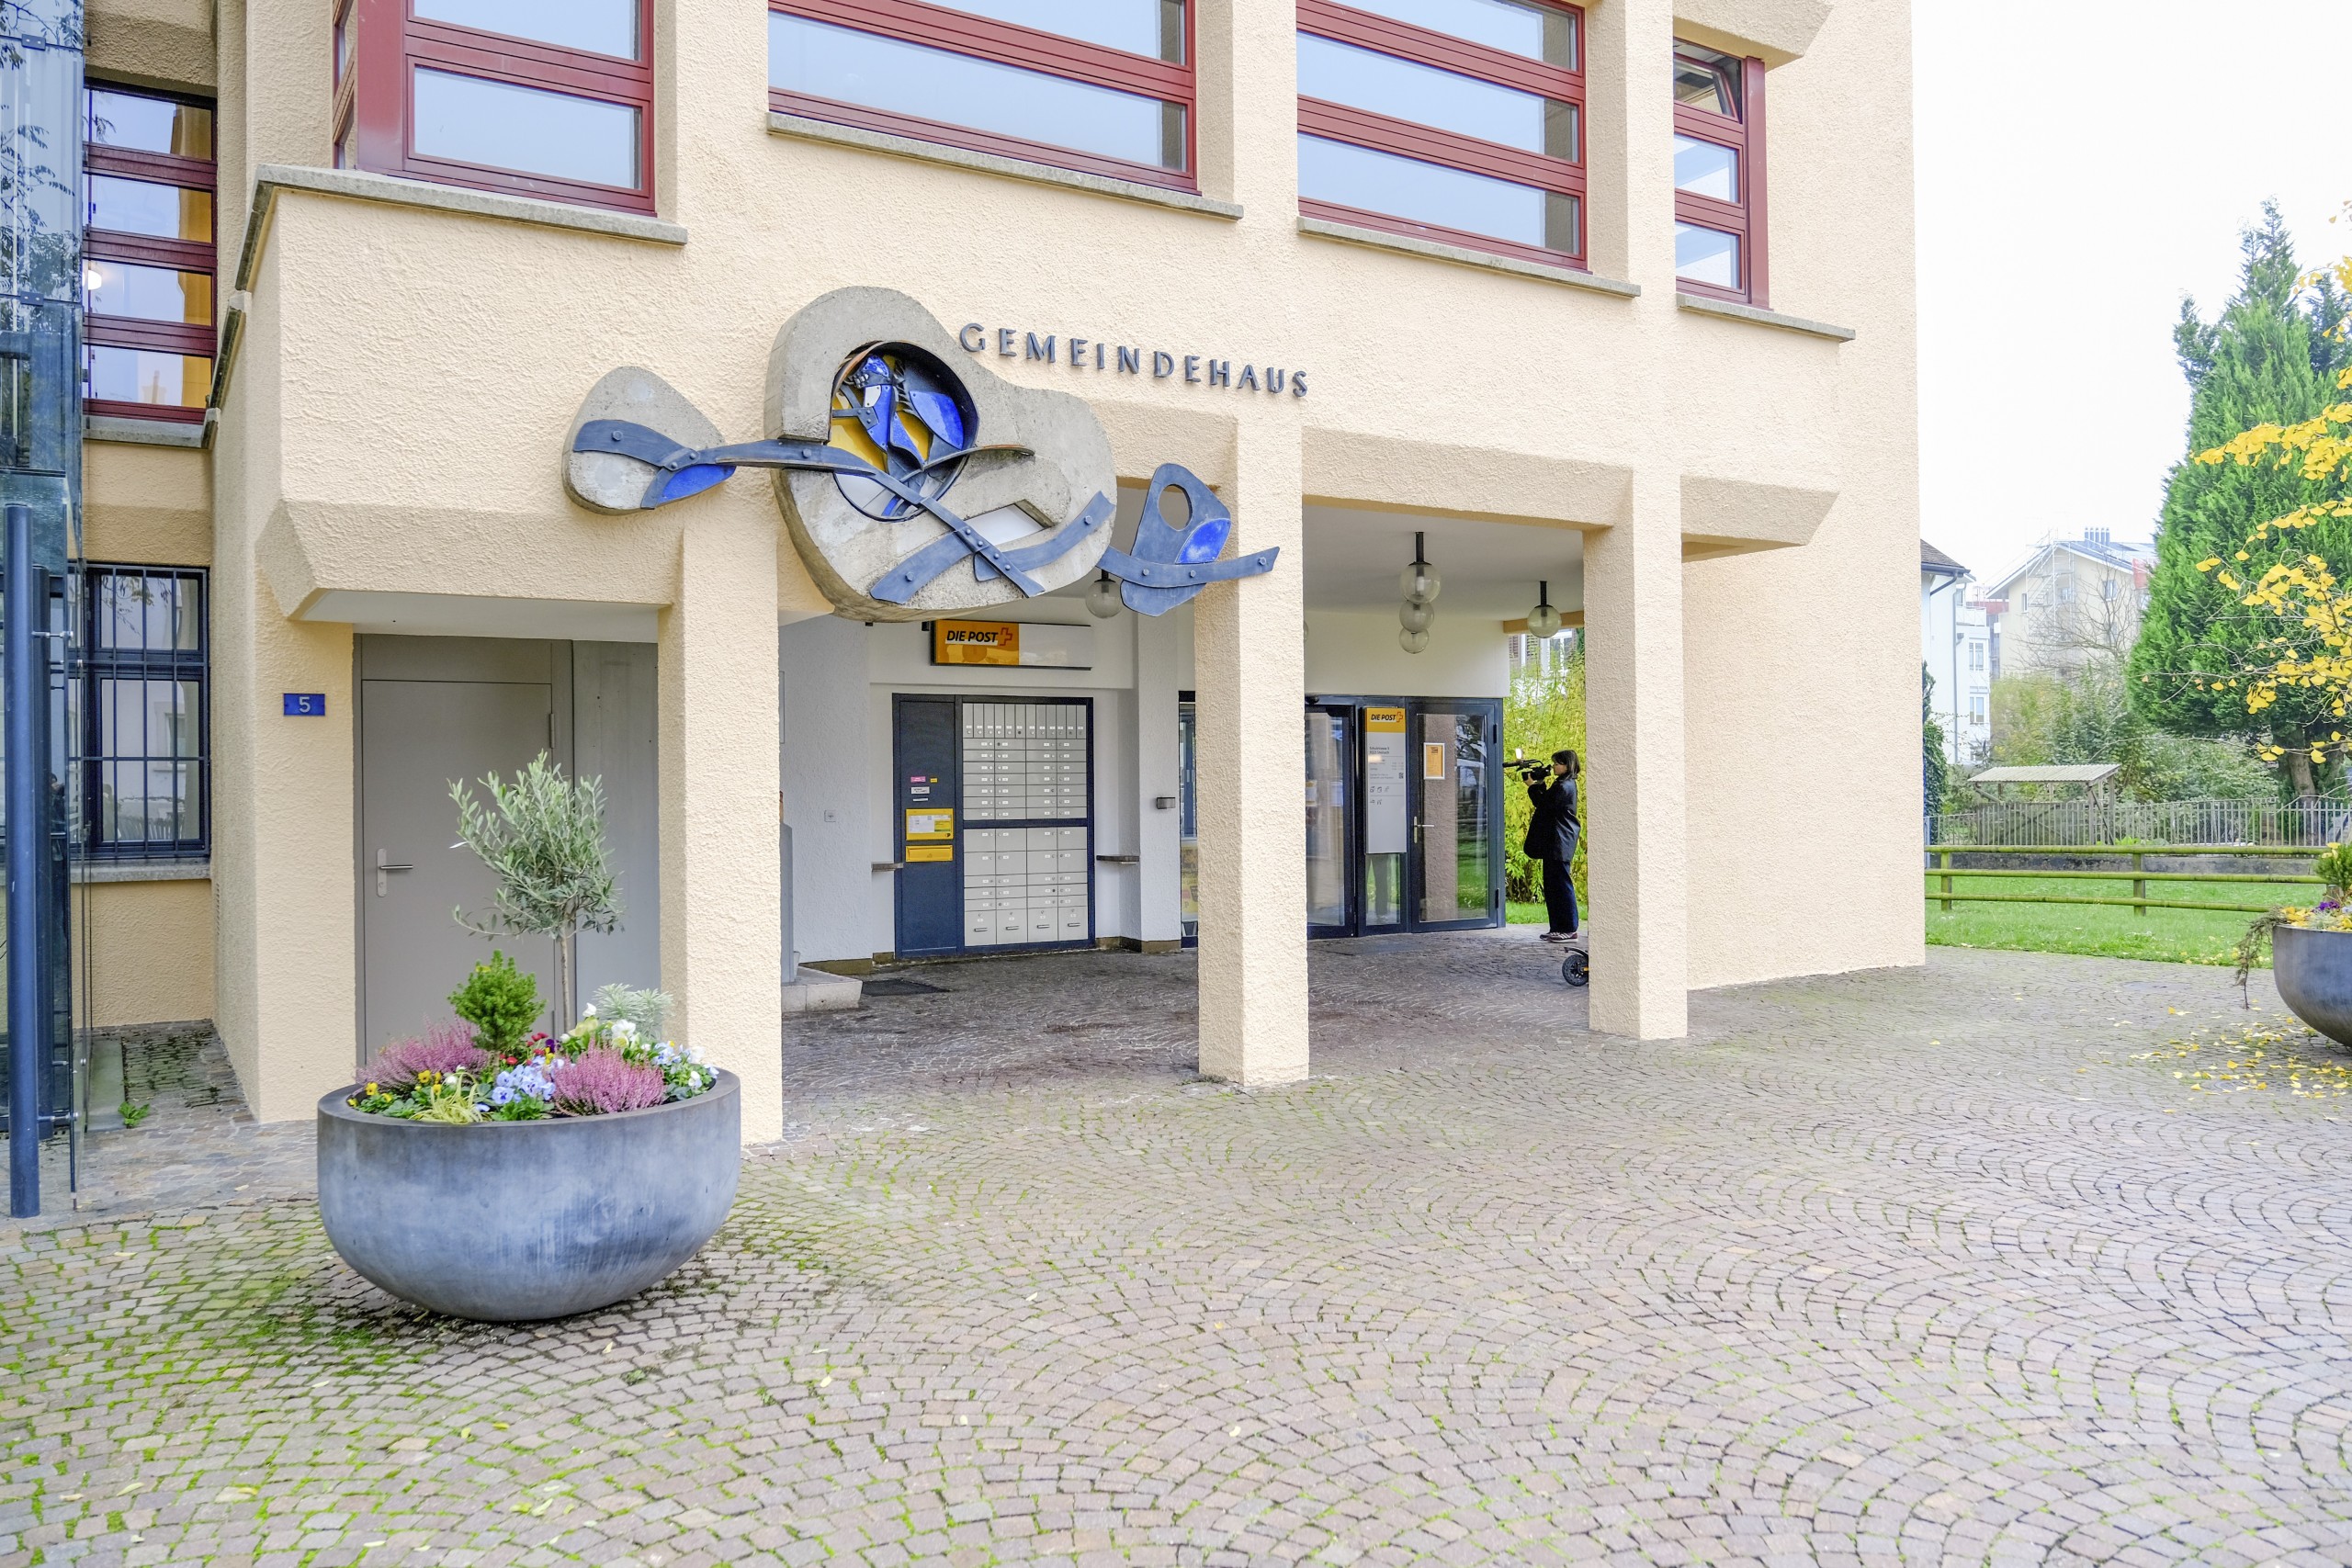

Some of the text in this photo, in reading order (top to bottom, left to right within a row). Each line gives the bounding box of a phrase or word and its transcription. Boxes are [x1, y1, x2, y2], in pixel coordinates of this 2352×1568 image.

[959, 322, 1307, 398] GEMEINDEHAUS
[946, 630, 999, 642] DIE POST
[299, 696, 311, 713] 5
